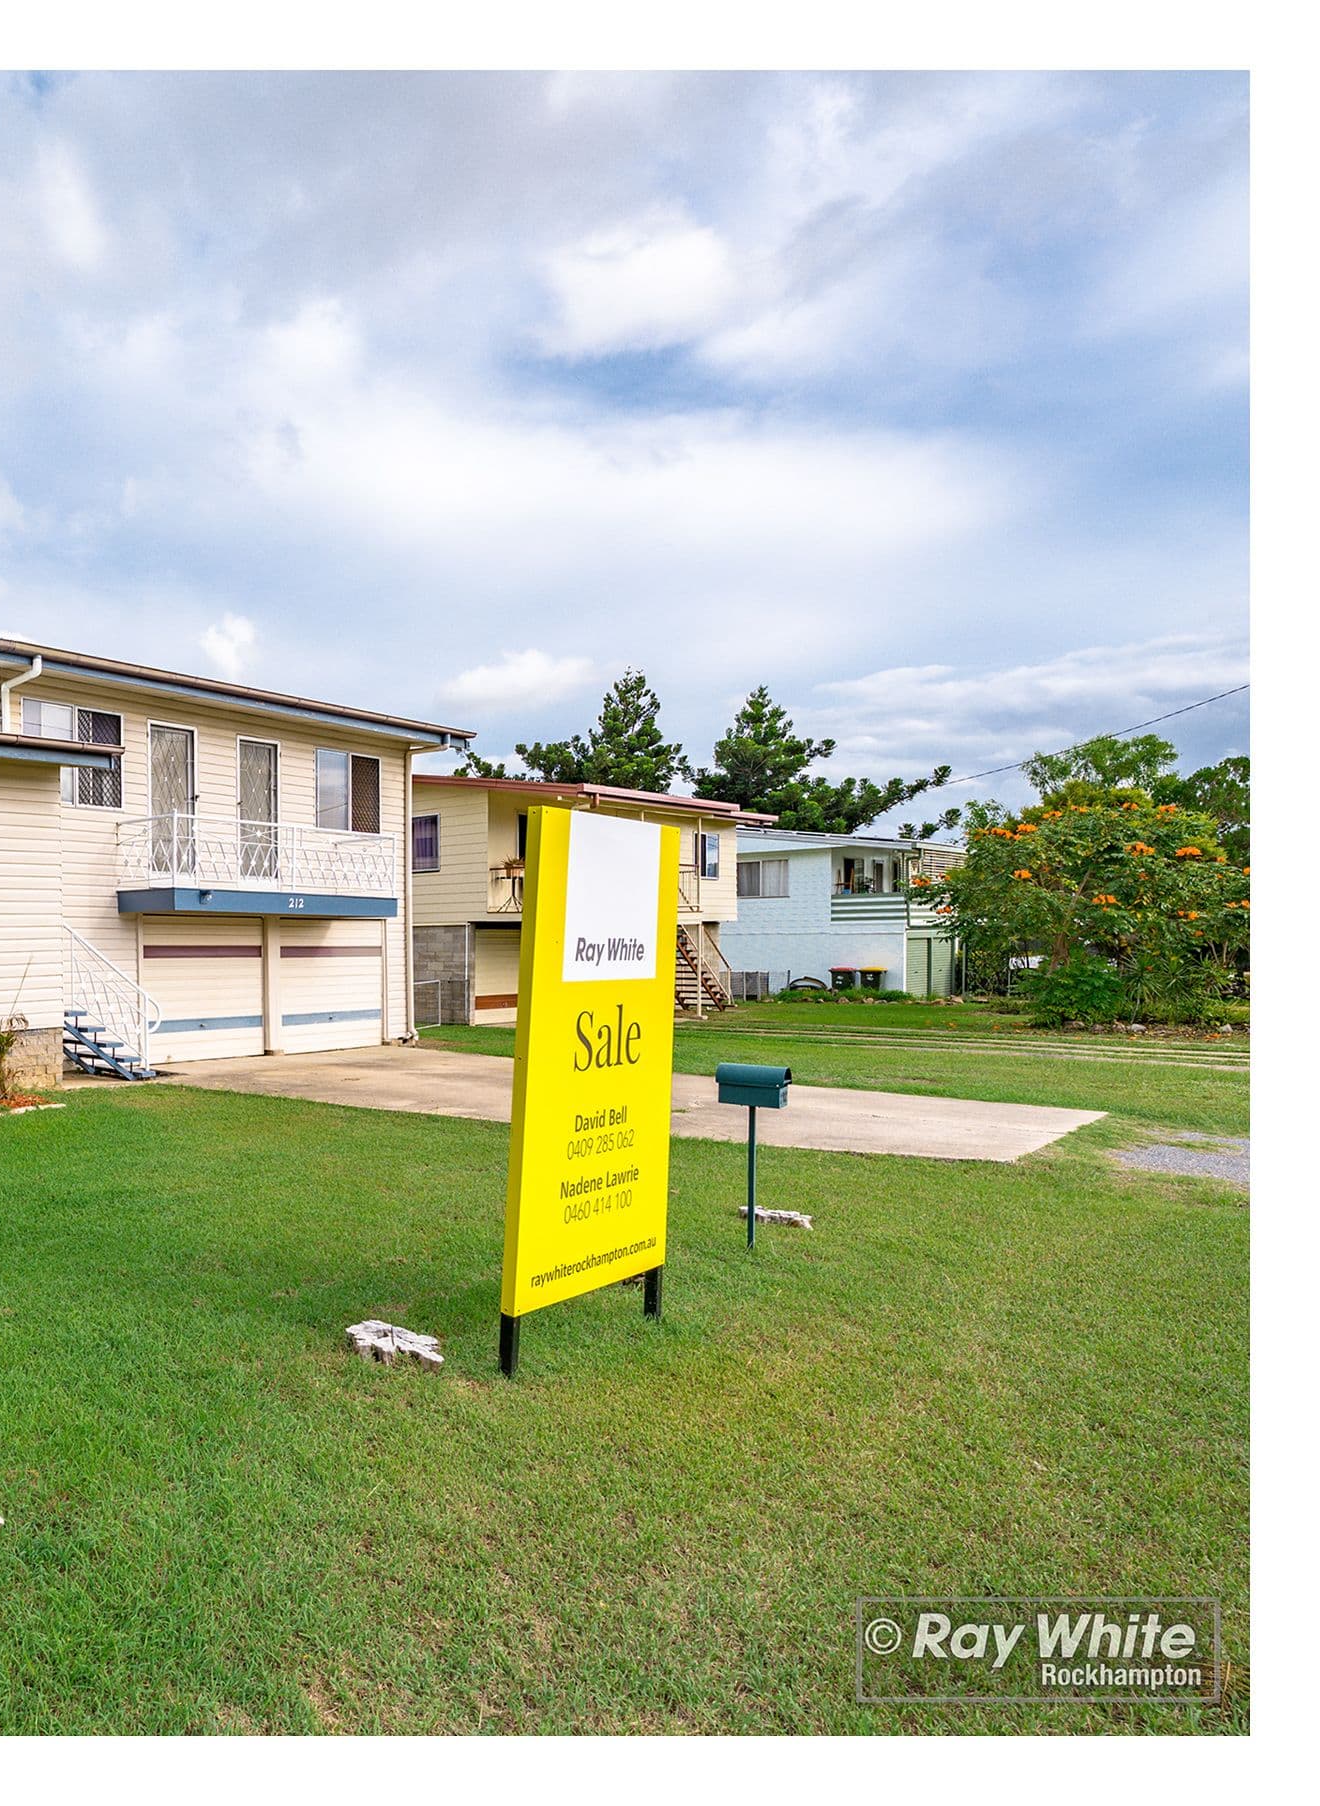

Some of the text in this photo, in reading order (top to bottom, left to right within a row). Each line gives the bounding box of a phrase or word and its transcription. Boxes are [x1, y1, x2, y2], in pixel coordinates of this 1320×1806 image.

[288, 897, 305, 909] 212
[575, 937, 645, 966] Ray White
[573, 1004, 642, 1072] Sale
[575, 1105, 628, 1133] David Bell
[567, 1128, 635, 1160] 0409 285 062
[560, 1164, 639, 1200] Nadene Lawrie
[564, 1189, 633, 1224] 0460 414 100
[530, 1236, 657, 1288] raywhiterockhampton.com.au
